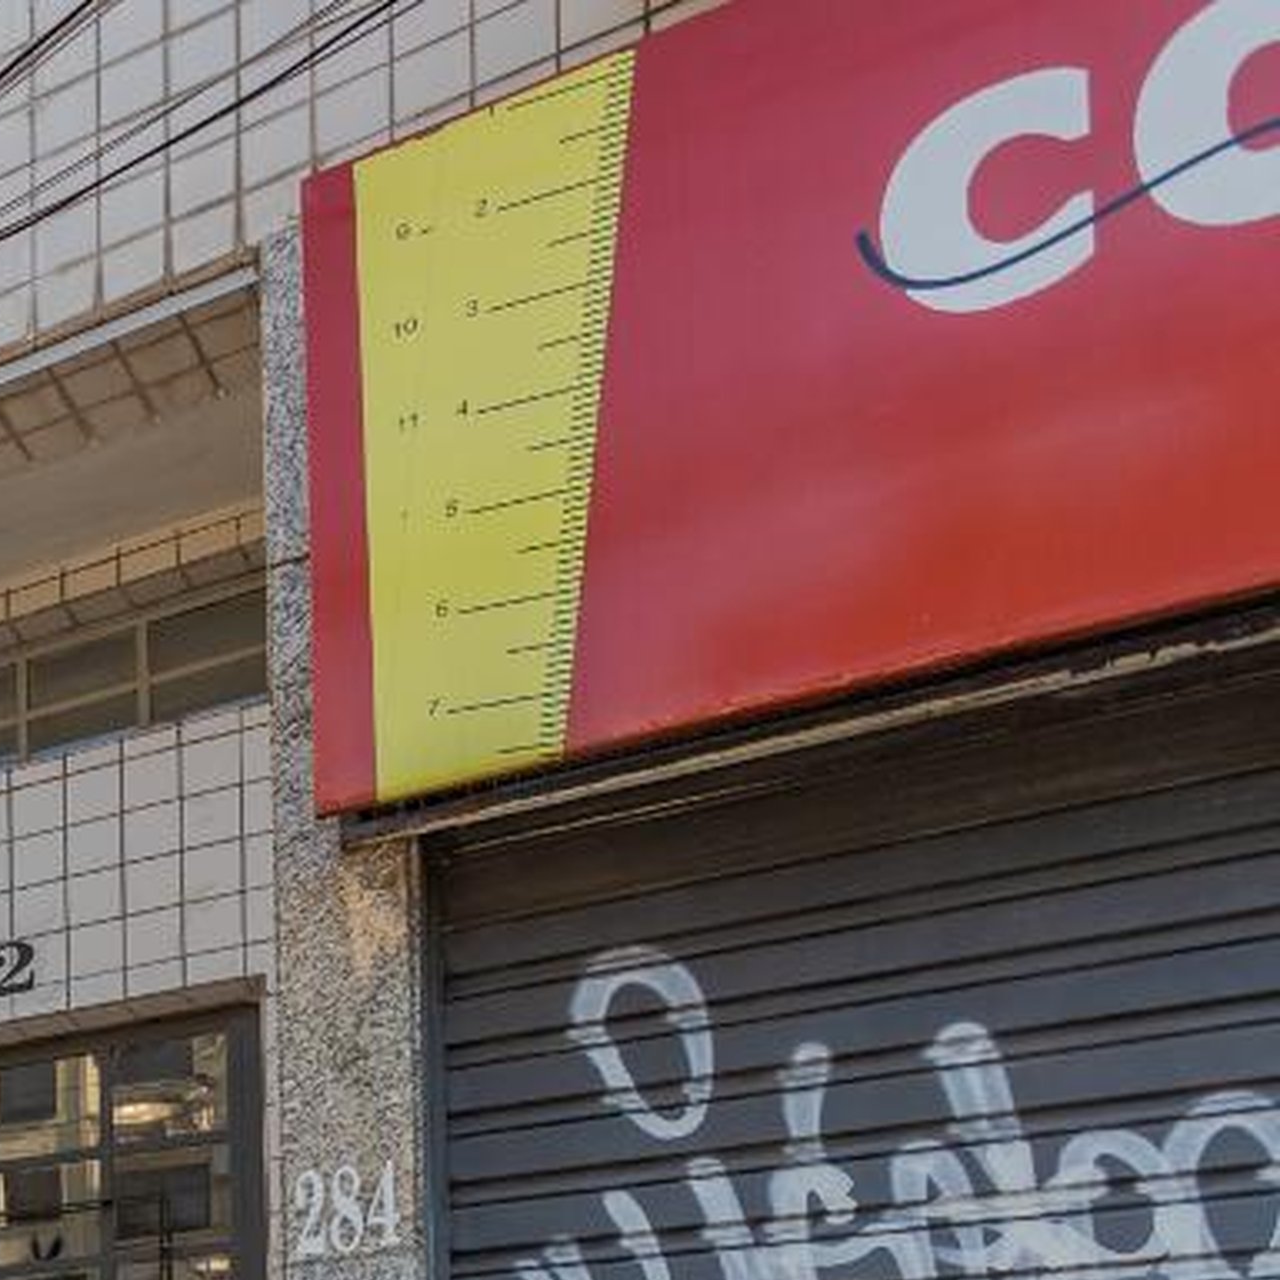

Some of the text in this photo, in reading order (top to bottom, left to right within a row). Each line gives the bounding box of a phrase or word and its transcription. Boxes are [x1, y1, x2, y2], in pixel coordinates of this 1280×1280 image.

[466, 299, 478, 317] 3
[394, 318, 418, 338] 10
[445, 499, 458, 518] 5
[436, 600, 448, 618] 6
[296, 1160, 401, 1255] 284
